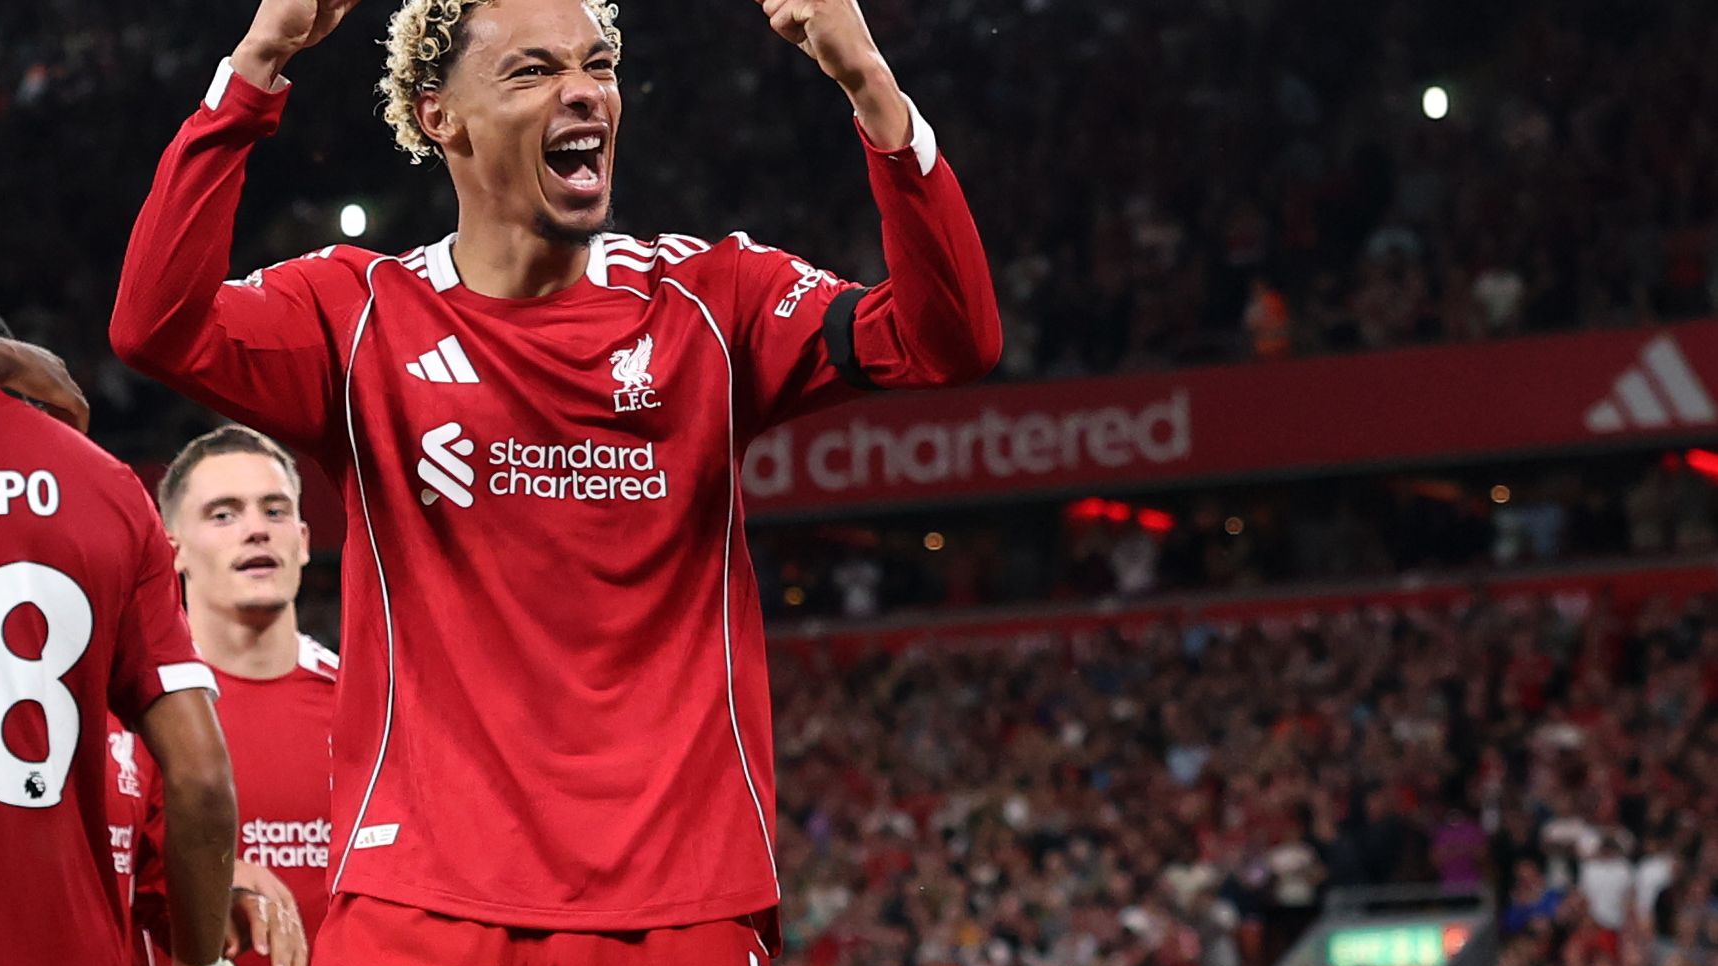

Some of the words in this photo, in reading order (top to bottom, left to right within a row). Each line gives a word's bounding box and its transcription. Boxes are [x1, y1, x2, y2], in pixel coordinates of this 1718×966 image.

[488, 436, 656, 471] standard
[807, 391, 1190, 490] chartered
[488, 467, 668, 500] chartered
[242, 816, 332, 843] stand
